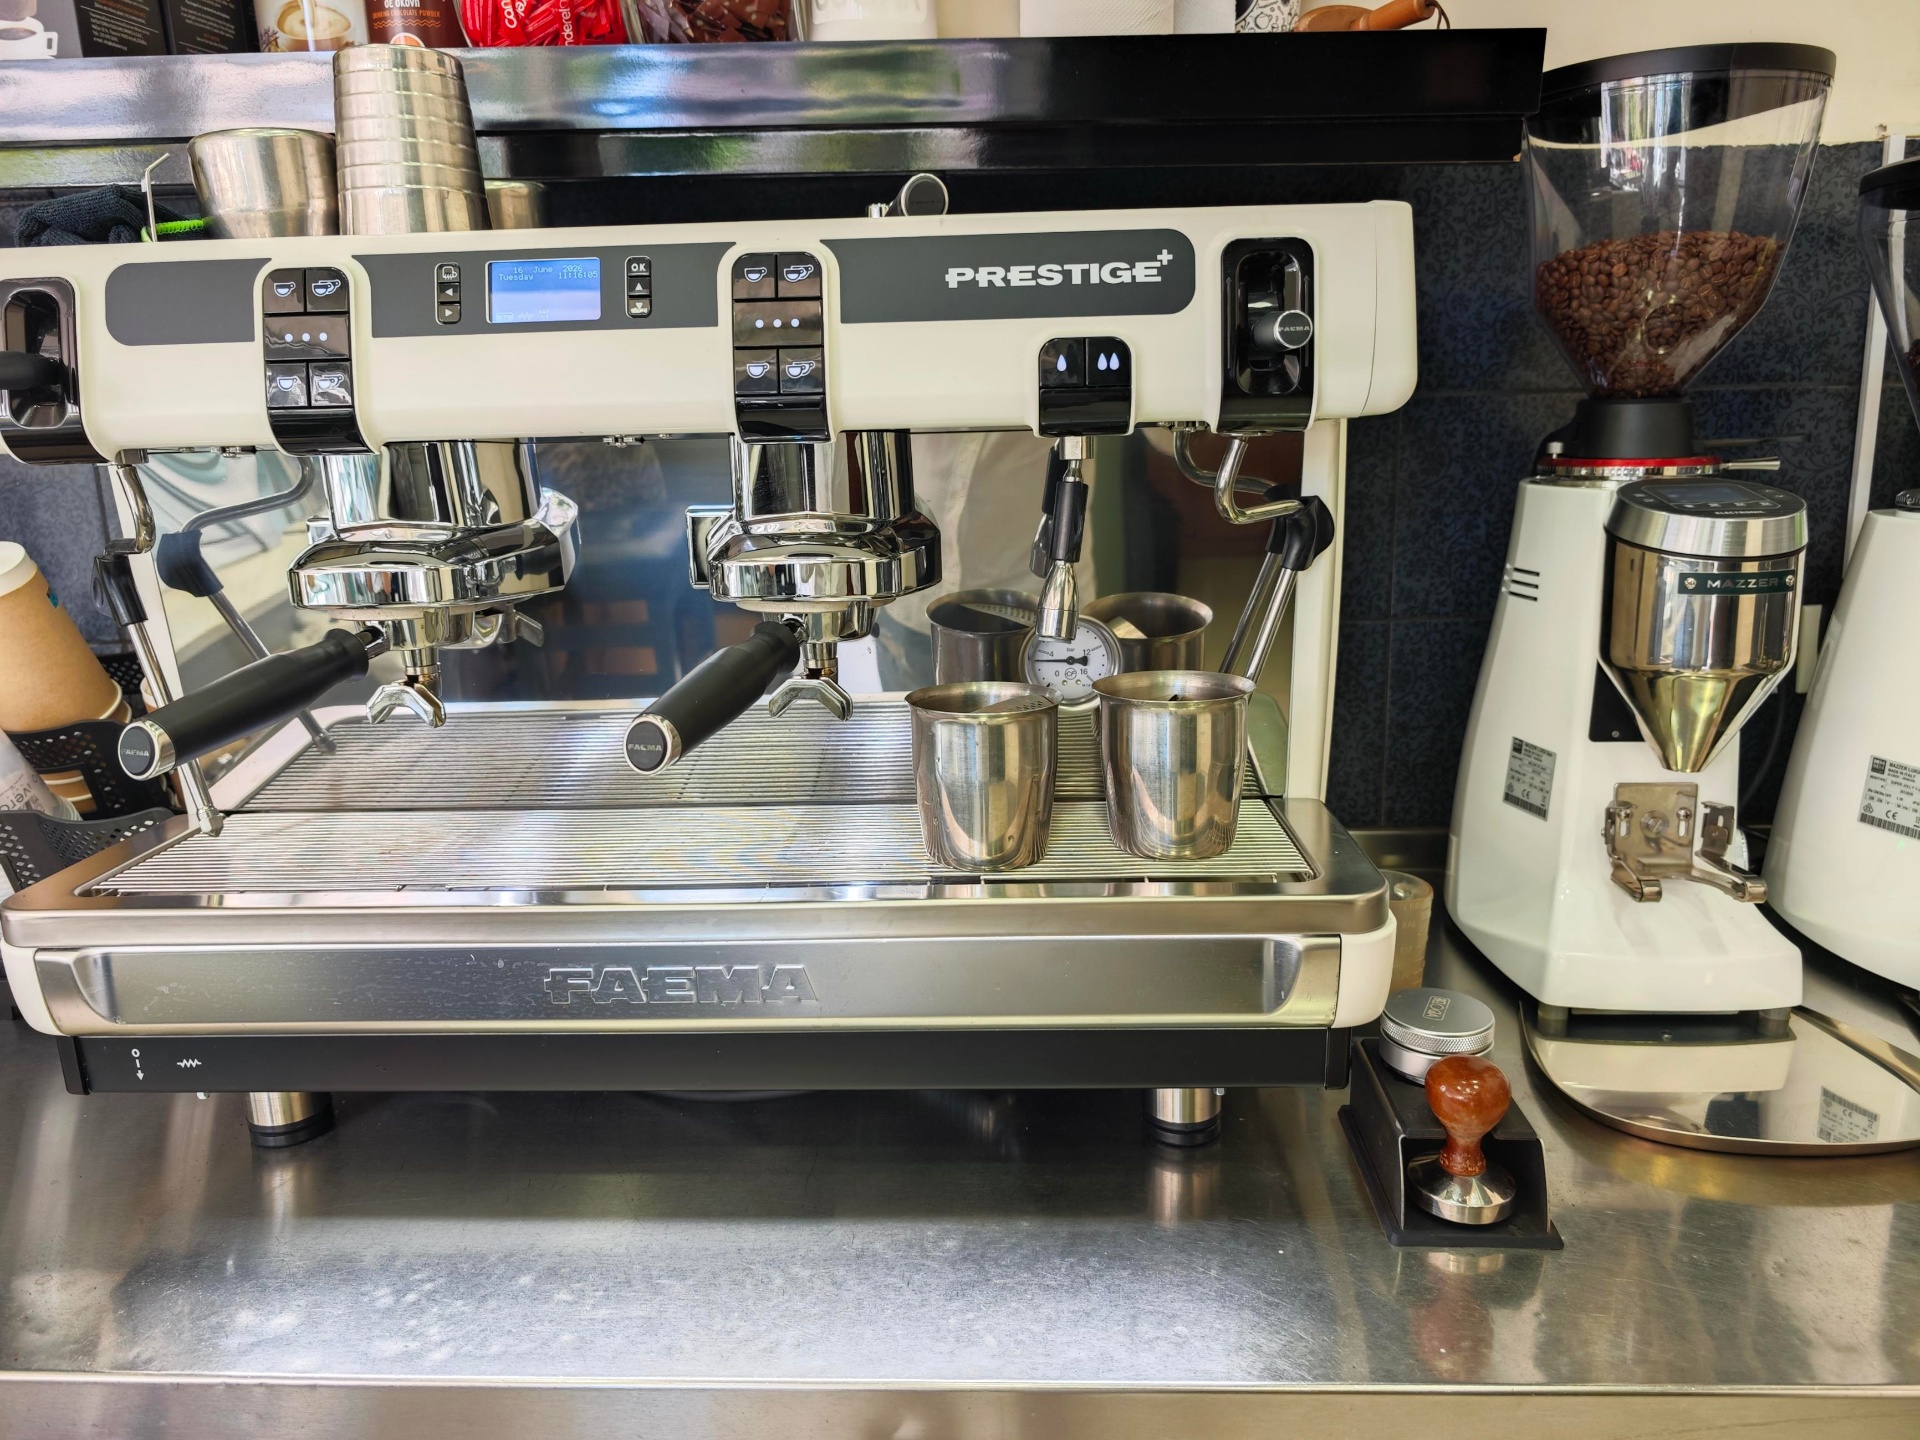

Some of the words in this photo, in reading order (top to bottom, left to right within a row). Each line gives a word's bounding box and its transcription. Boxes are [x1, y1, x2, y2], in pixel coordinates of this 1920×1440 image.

[391, 9, 418, 17] CHOCOLATE
[419, 10, 441, 18] POWDER
[513, 266, 524, 274] 16
[533, 265, 553, 274] June
[563, 264, 583, 272] 2026
[630, 262, 646, 272] OK
[498, 273, 534, 281] Tuesday
[558, 271, 599, 280] 11:16:05
[1706, 578, 1779, 589] MAZZER
[627, 743, 662, 751] FAEMA
[544, 964, 818, 1004] FAEMA
